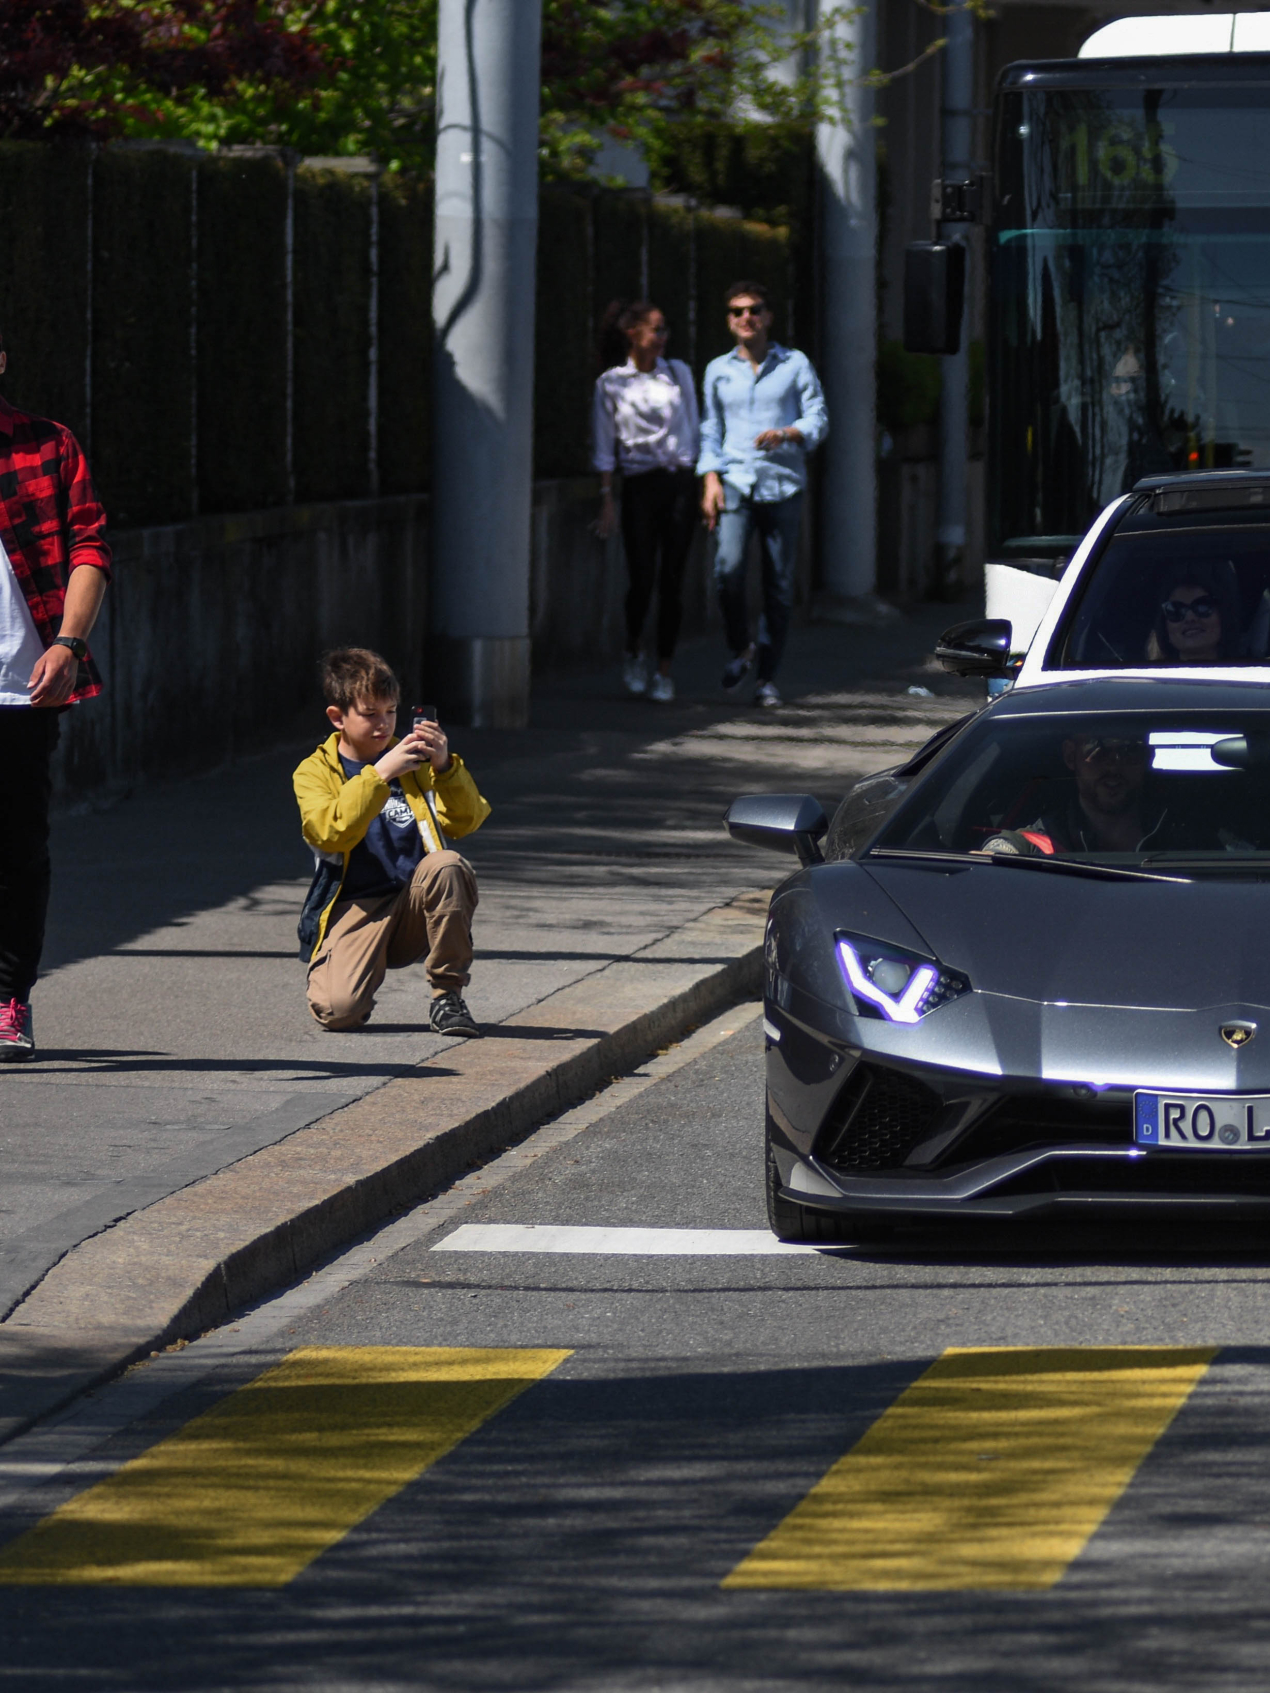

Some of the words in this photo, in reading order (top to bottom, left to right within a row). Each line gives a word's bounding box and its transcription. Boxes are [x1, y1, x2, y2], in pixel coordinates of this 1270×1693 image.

[1070, 122, 1179, 185] 165
[1143, 1124, 1152, 1136] D
[1163, 1101, 1215, 1141] RO
